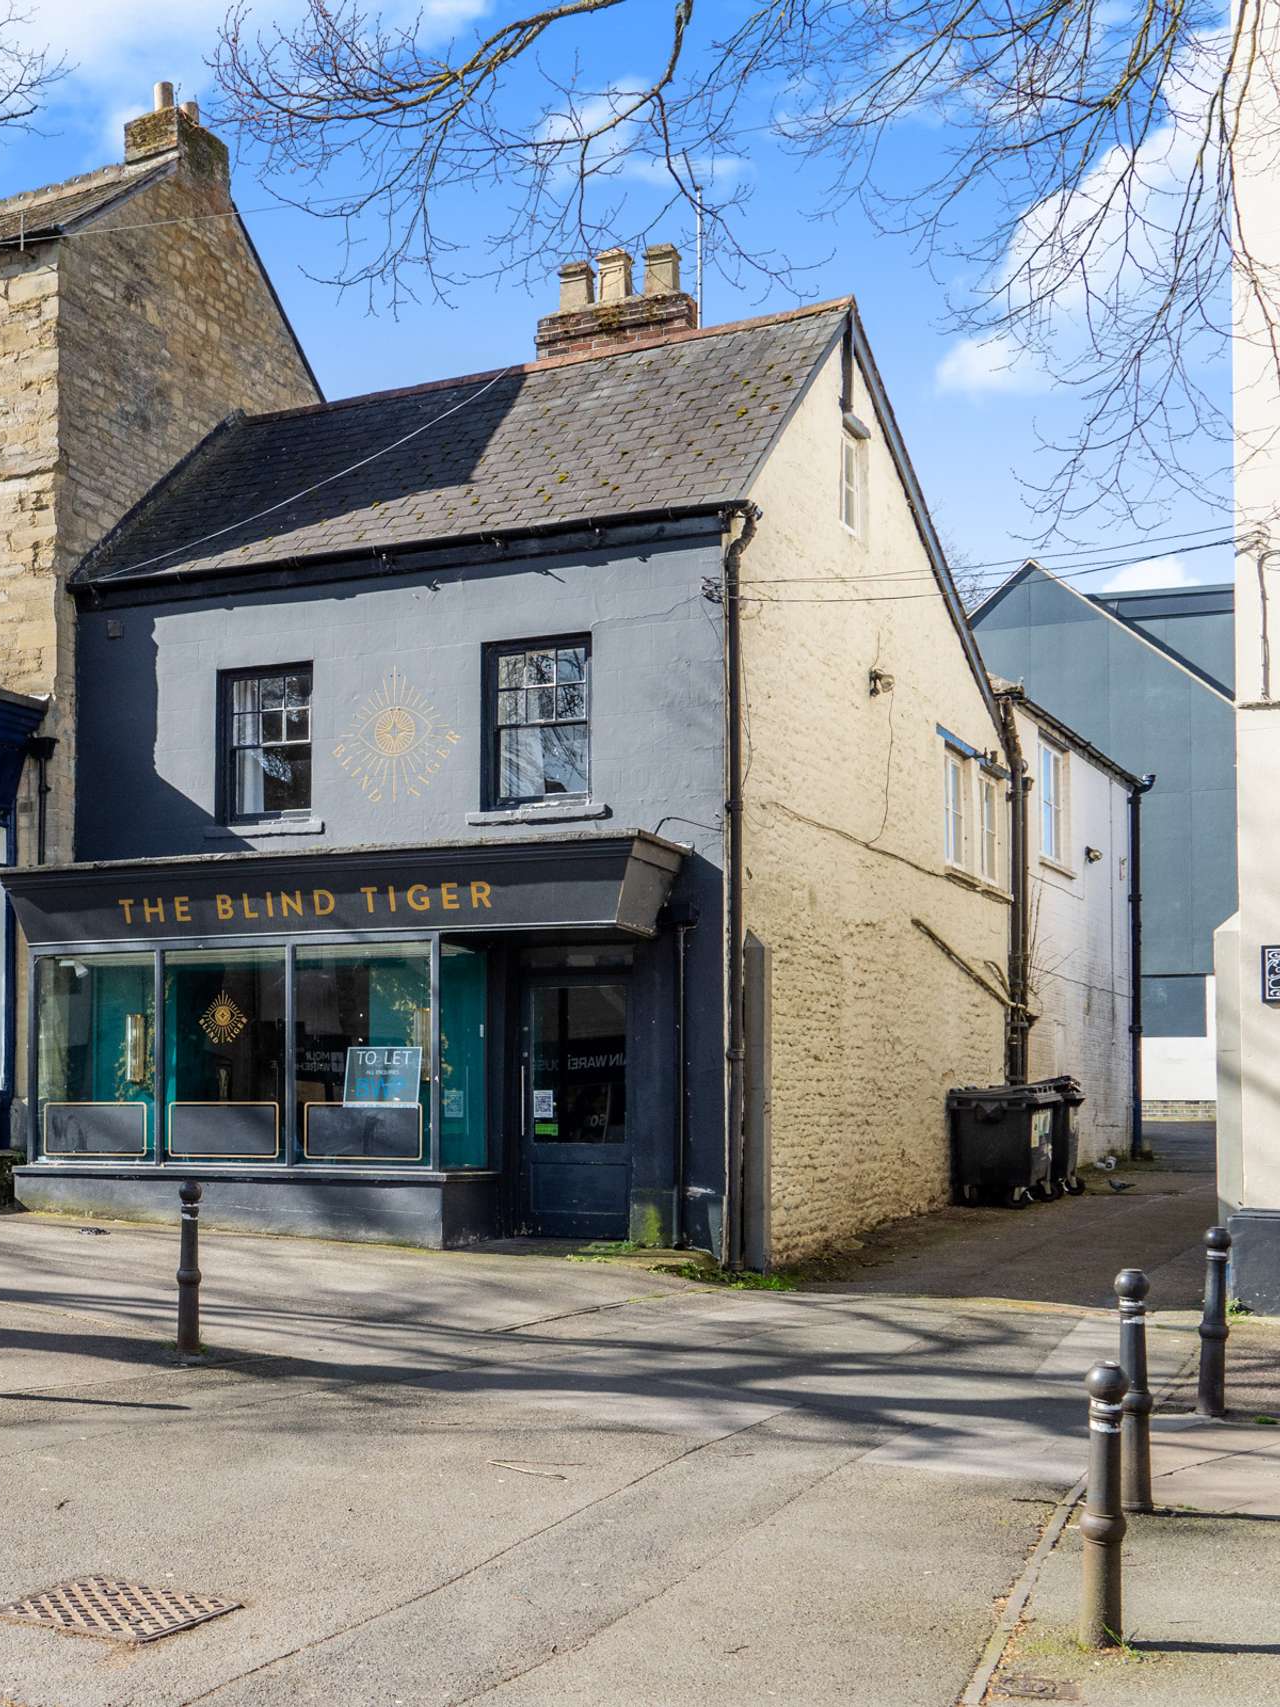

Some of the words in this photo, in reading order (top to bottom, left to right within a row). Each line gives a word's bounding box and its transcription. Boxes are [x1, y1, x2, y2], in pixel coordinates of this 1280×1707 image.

[330, 743, 382, 801] BLIND
[407, 730, 460, 797] TIGER
[118, 896, 192, 924] THE
[216, 889, 336, 920] BLIND
[360, 881, 492, 913] TIGER
[199, 1018, 219, 1044] BLIND
[356, 1051, 377, 1065] TO
[384, 1051, 412, 1065] LET
